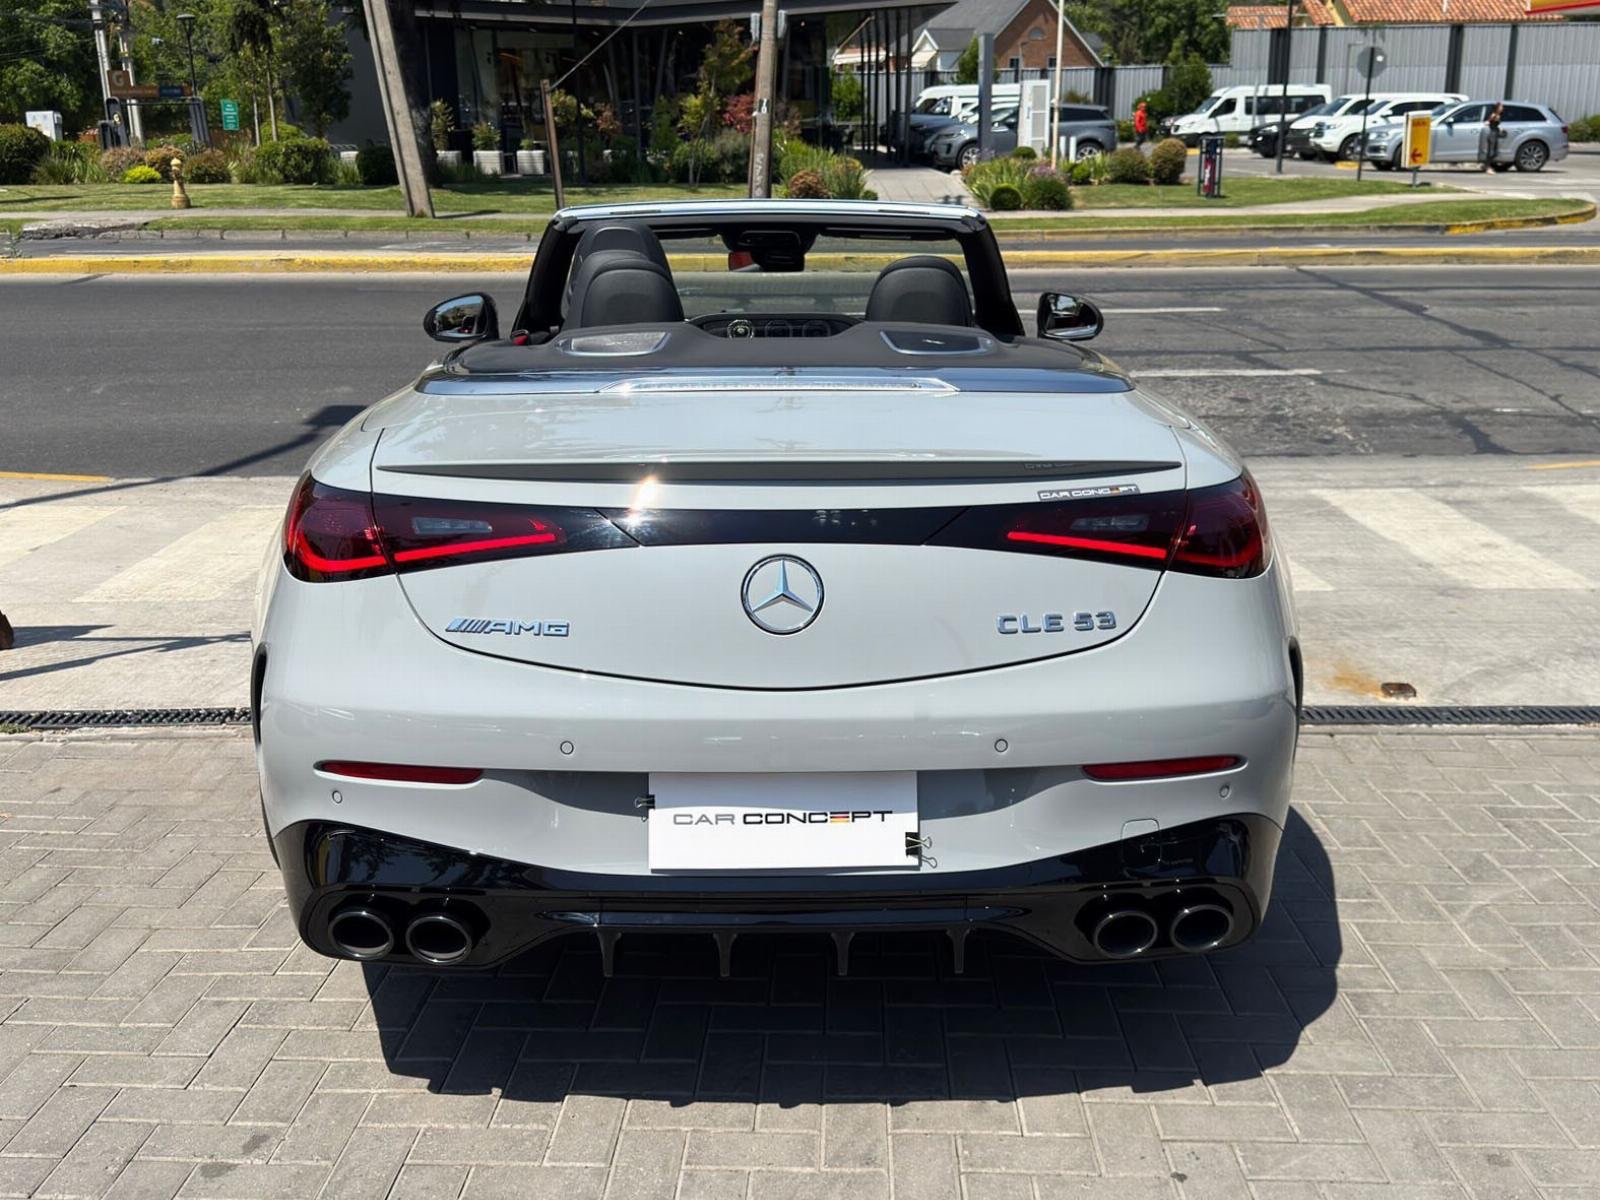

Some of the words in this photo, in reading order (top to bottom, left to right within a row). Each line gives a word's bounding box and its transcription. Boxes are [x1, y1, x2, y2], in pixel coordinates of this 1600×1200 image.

[1039, 490, 1071, 500] CAR
[482, 618, 570, 637] AMG
[997, 612, 1064, 635] CLE
[1073, 610, 1117, 632] 53
[673, 813, 735, 825] CAR
[743, 811, 893, 825] CONCEPT
